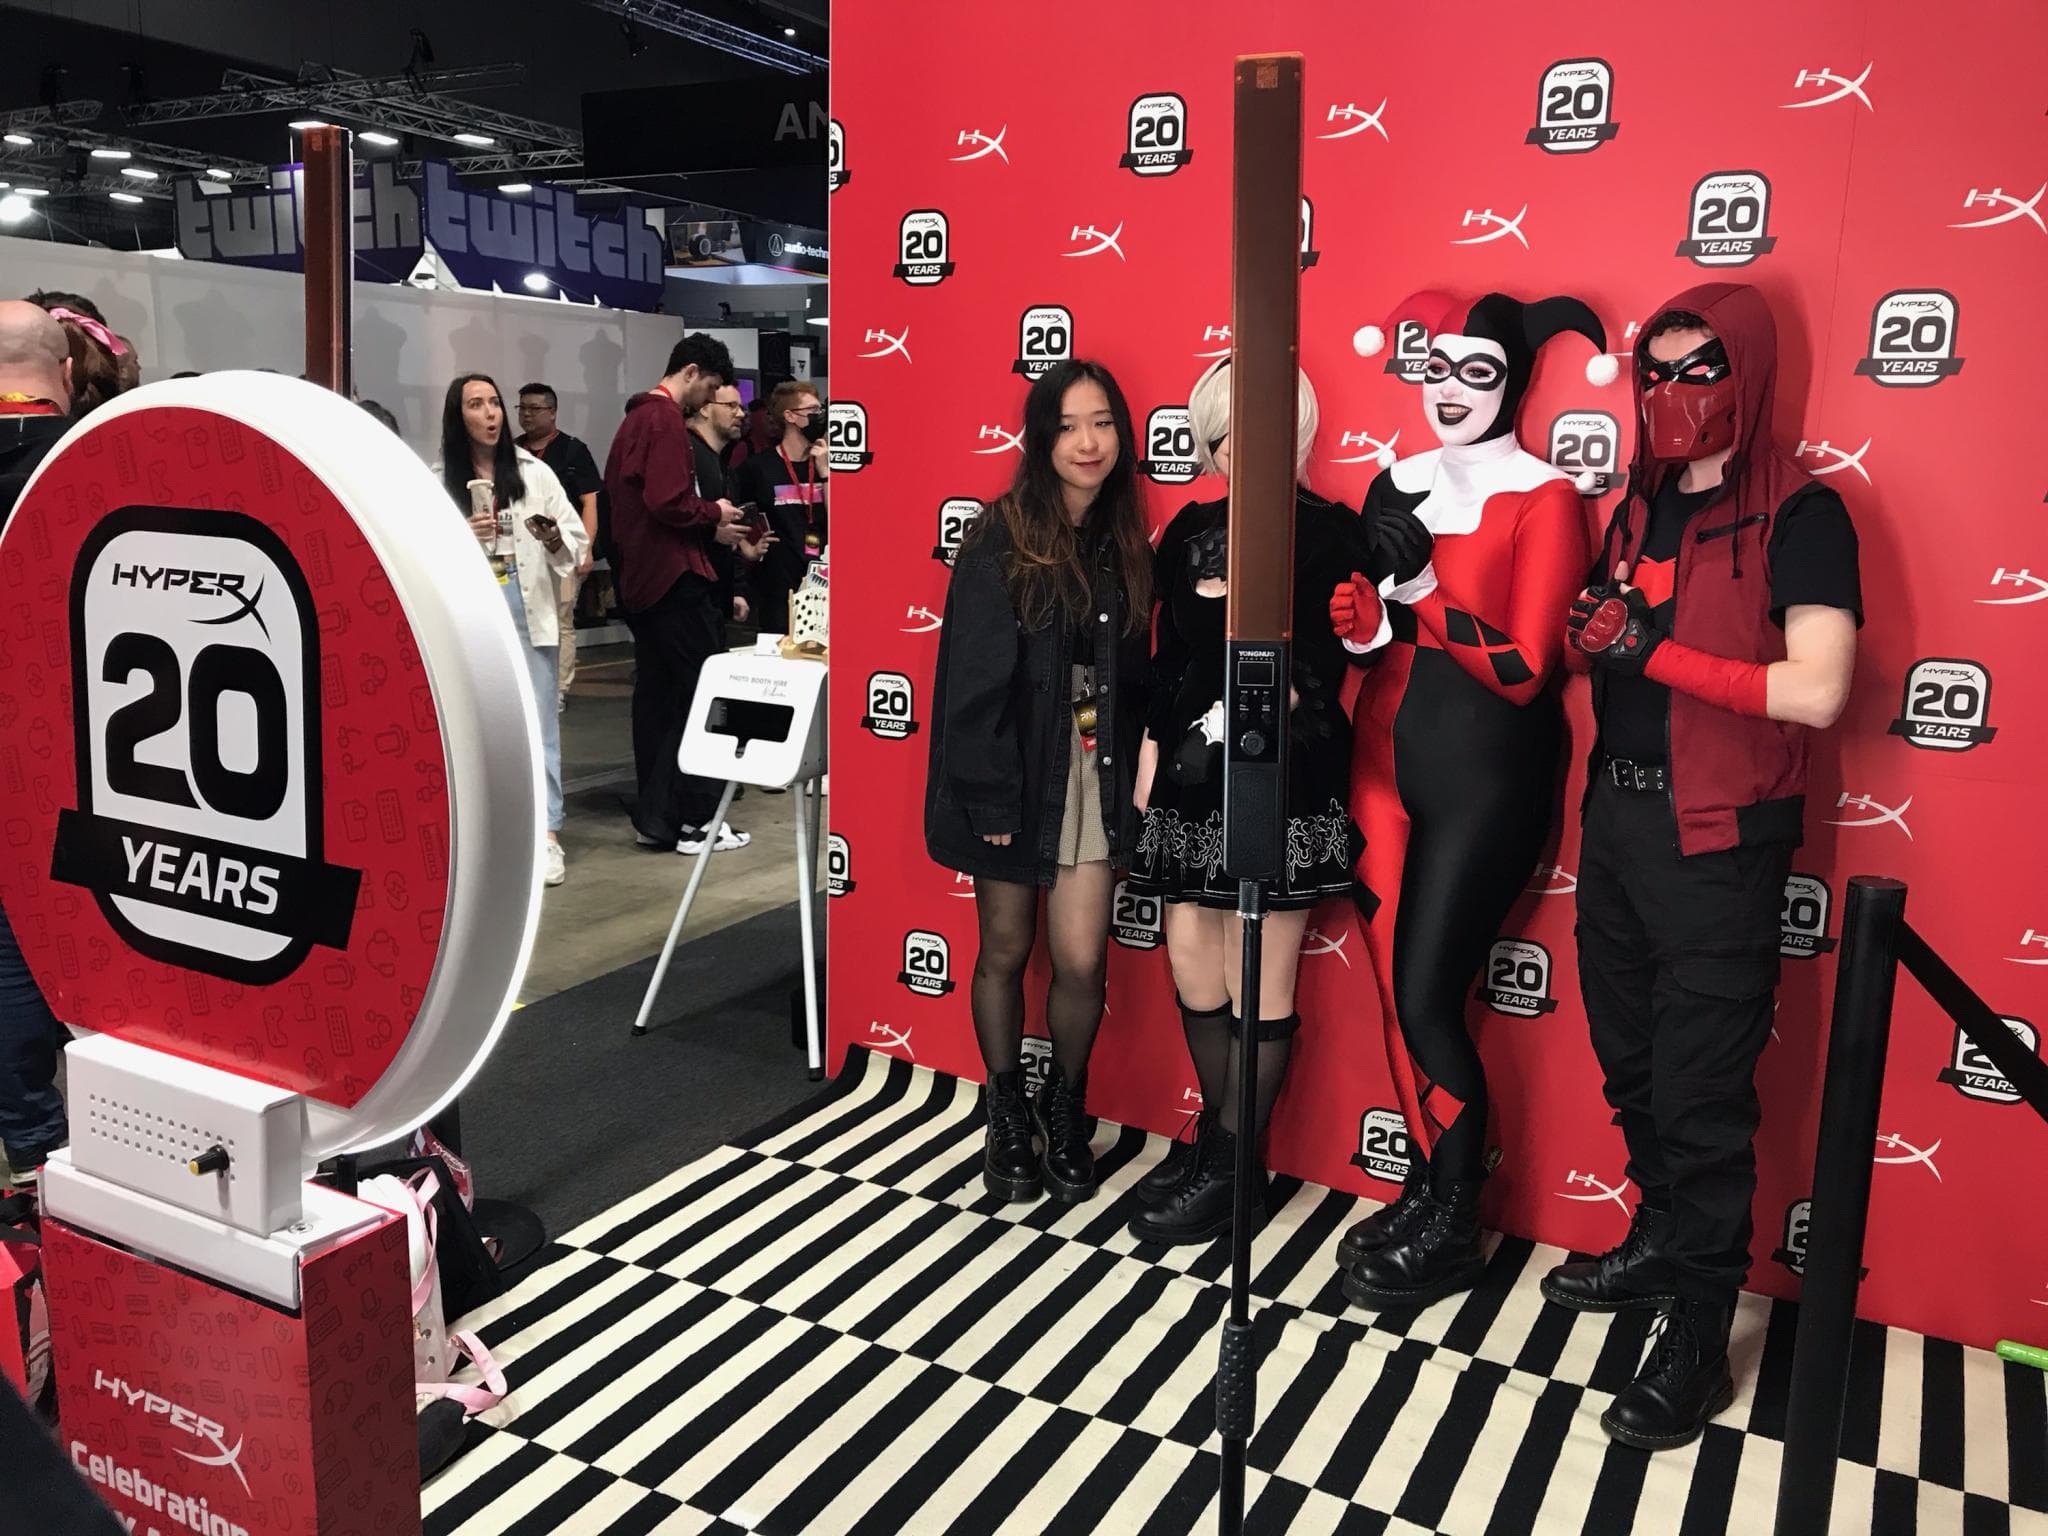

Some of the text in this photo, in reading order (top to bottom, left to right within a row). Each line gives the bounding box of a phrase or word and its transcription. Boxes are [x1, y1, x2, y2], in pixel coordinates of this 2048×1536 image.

[1554, 68, 1601, 82] HYPERX
[1546, 83, 1603, 122] 20
[1135, 115, 1179, 148] 20
[1548, 127, 1597, 141] YEARS
[1137, 153, 1176, 165] YEARS
[1706, 181, 1757, 194] HYPERX
[426, 161, 666, 285] twitch
[1698, 196, 1759, 234] 20
[905, 230, 943, 260] 20
[1700, 240, 1752, 254] YEARS
[907, 265, 941, 275] YEARS
[1890, 300, 1943, 313] HYPERX
[1025, 326, 1067, 357] 20
[1402, 321, 1430, 354] 2
[1879, 315, 1947, 353] 20
[1028, 362, 1057, 372] YEA
[1405, 360, 1429, 371] YEA
[1881, 360, 1938, 373] YEARS
[829, 420, 862, 448] 20
[1152, 426, 1194, 457] 20
[829, 452, 861, 463] YEARS
[1556, 433, 1611, 467] 20
[1154, 463, 1192, 474] YEARS
[112, 562, 272, 645] HYPERX
[1922, 667, 1976, 682] HYPERX
[873, 688, 909, 716] 20
[1912, 681, 1979, 720] 20
[102, 631, 289, 821] 20
[875, 718, 907, 731] YEARS
[1914, 723, 1971, 740] YEARS
[122, 835, 281, 915] YEARS
[1117, 895, 1158, 926] 20
[1118, 927, 1154, 941] YEARS
[1781, 934, 1814, 948] ARS
[909, 945, 944, 973] 20
[911, 976, 942, 989] YEARS
[1492, 957, 1541, 992] 20
[1494, 990, 1538, 1008] YEARS
[1366, 1126, 1408, 1160] 20
[1368, 1158, 1409, 1175] YEARS
[94, 1369, 253, 1499] HYPERX
[70, 1440, 249, 1536] Celebration
